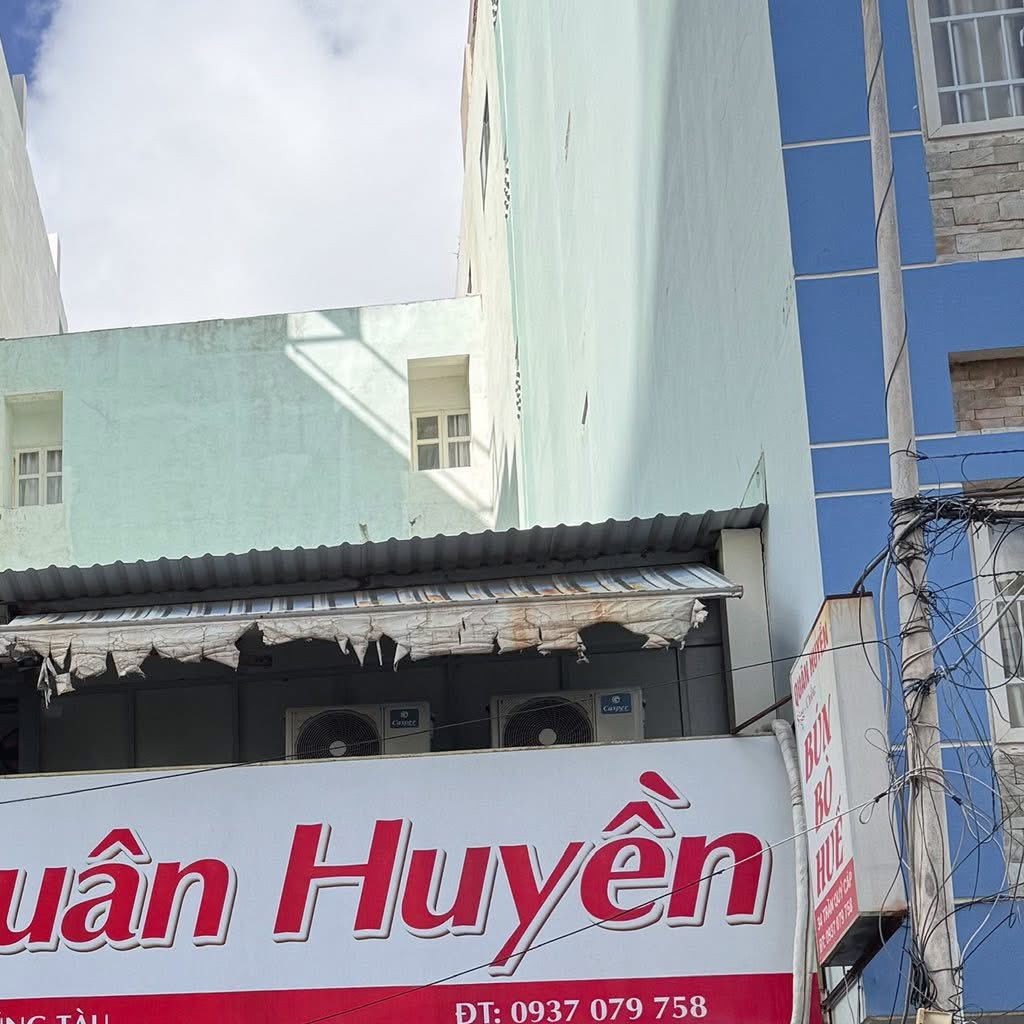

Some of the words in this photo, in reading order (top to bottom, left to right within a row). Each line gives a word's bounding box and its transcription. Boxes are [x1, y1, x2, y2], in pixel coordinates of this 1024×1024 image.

[803, 693, 833, 782] BÚN
[814, 757, 834, 832] BÒ
[273, 770, 773, 978] Huyền
[815, 794, 847, 898] HUẾ
[455, 1002, 501, 1024] ĐT:
[510, 999, 578, 1024] 0937
[589, 997, 644, 1022] 079
[653, 995, 708, 1020] 758
